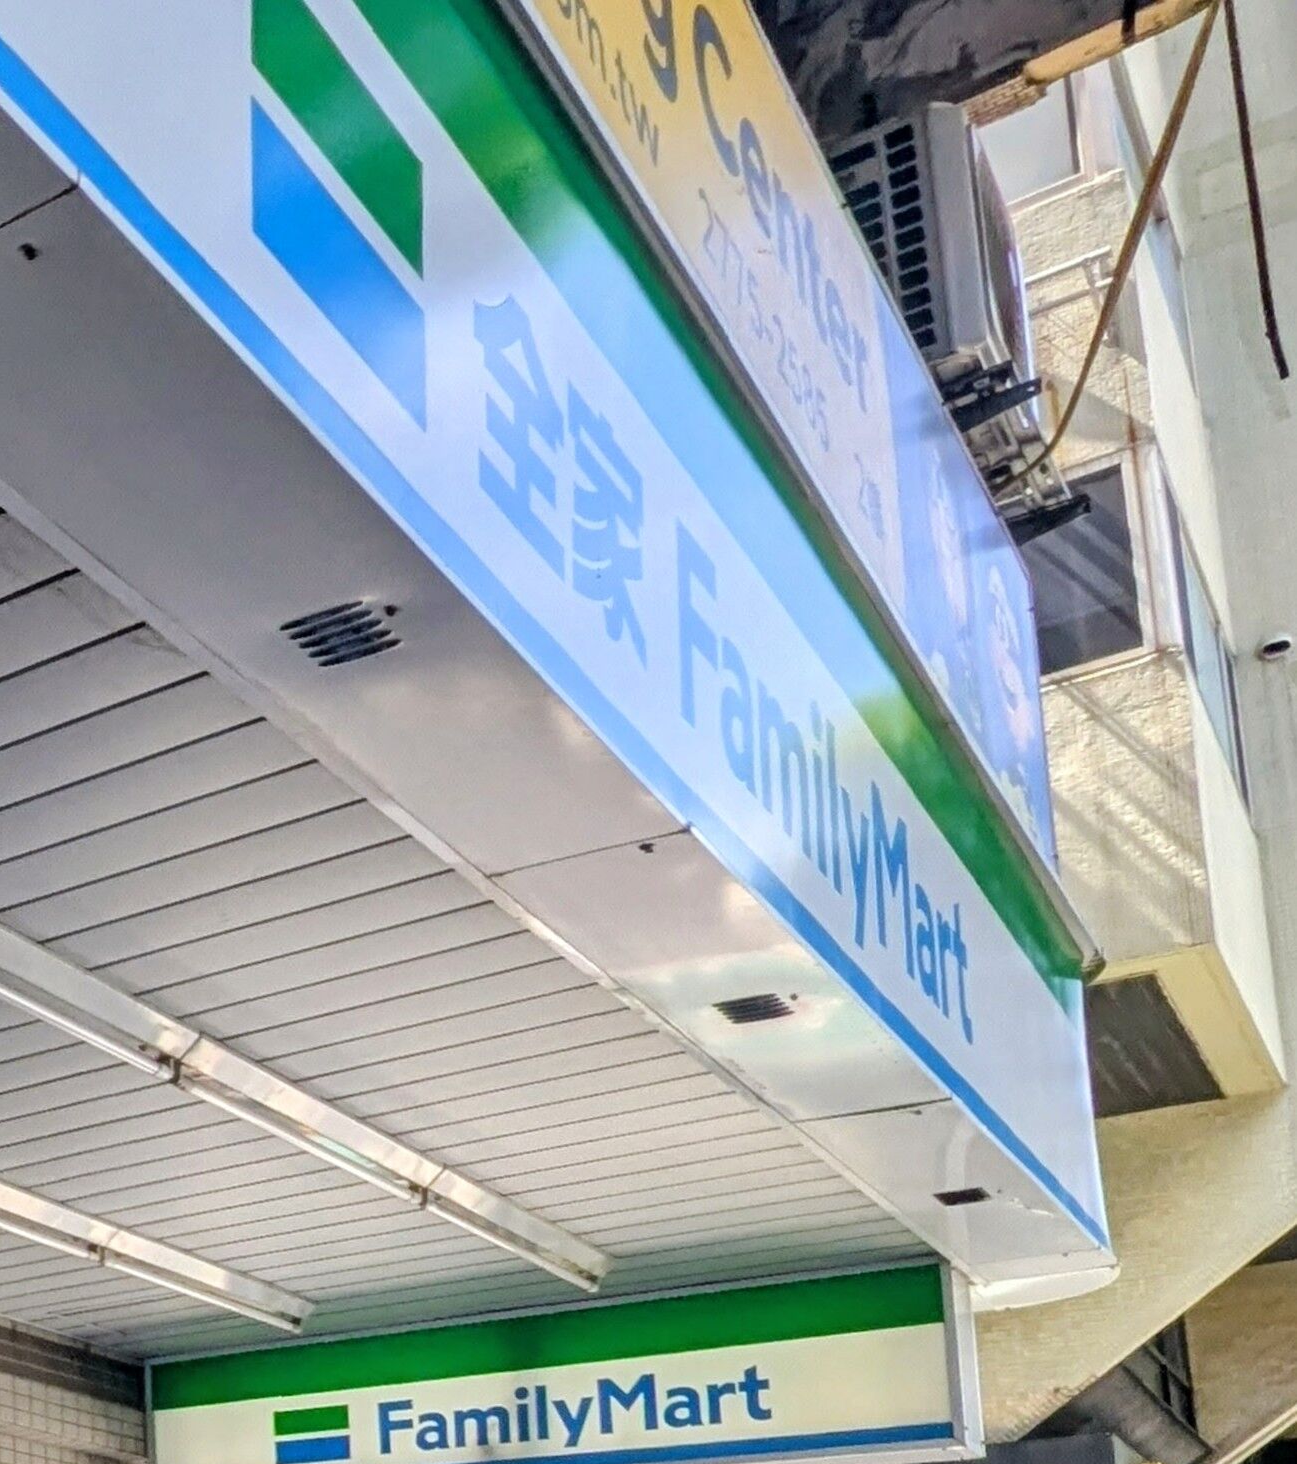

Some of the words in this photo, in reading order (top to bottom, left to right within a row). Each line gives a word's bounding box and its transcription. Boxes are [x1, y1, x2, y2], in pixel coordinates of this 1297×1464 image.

[694, 4, 869, 415] Center
[474, 295, 648, 668] 全家
[676, 515, 975, 1047] FamilyMart
[379, 1365, 772, 1455] FamilyMart
